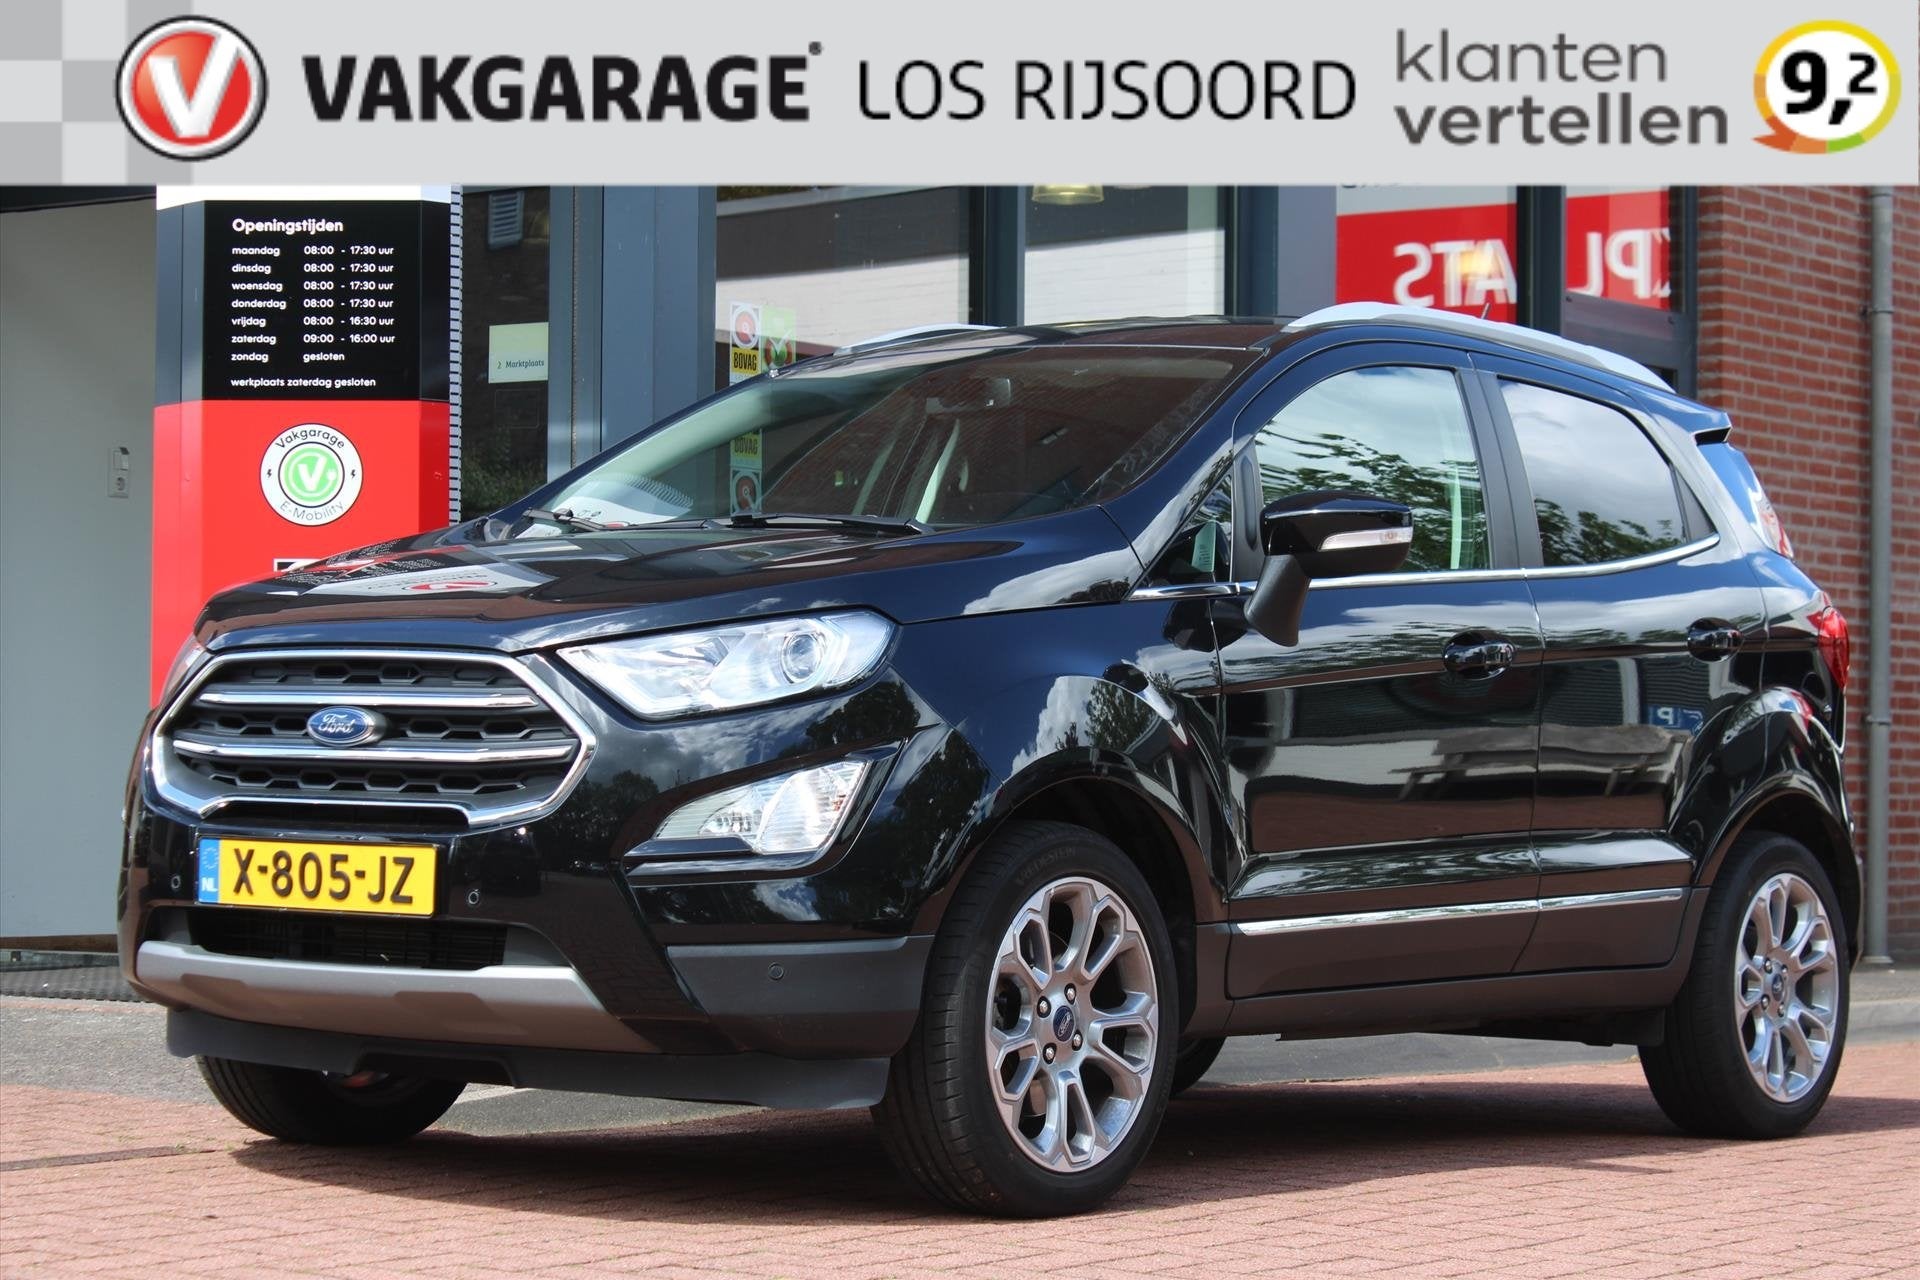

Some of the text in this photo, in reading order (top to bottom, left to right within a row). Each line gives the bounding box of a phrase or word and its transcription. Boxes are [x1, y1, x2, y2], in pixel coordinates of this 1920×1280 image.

[232, 218, 344, 235] Openingstijden
[231, 246, 281, 257] maandag
[303, 246, 334, 255] 08:00
[350, 246, 376, 255] 17:30
[231, 263, 272, 274] dinsdag
[303, 263, 334, 273] 08:00
[350, 263, 376, 273] 17:30
[378, 265, 394, 273] uur
[231, 281, 283, 292] woensdag
[303, 281, 334, 291] 08:00
[350, 281, 376, 291] 17:30
[378, 283, 394, 291] uur
[231, 299, 287, 310] donderdag
[303, 299, 334, 308] 08:00
[350, 299, 376, 308] 17:30
[231, 316, 267, 328] vrijdag
[303, 316, 334, 326] 08:00
[350, 316, 376, 326] 16:30
[379, 318, 395, 326] uur
[231, 334, 277, 345] zaterdag
[303, 334, 334, 343] 09:00
[350, 334, 378, 343] 16:00
[231, 351, 345, 363] zondag gesloten
[733, 352, 757, 371] BOVAG
[505, 359, 545, 369] Marktplaats
[231, 377, 376, 389] werkplaats zaterdag gesloten
[275, 429, 345, 449] Vakgarage
[279, 500, 344, 521] E-Mobility
[318, 713, 356, 733] Ford
[201, 847, 415, 905] NL X-805-JZ
